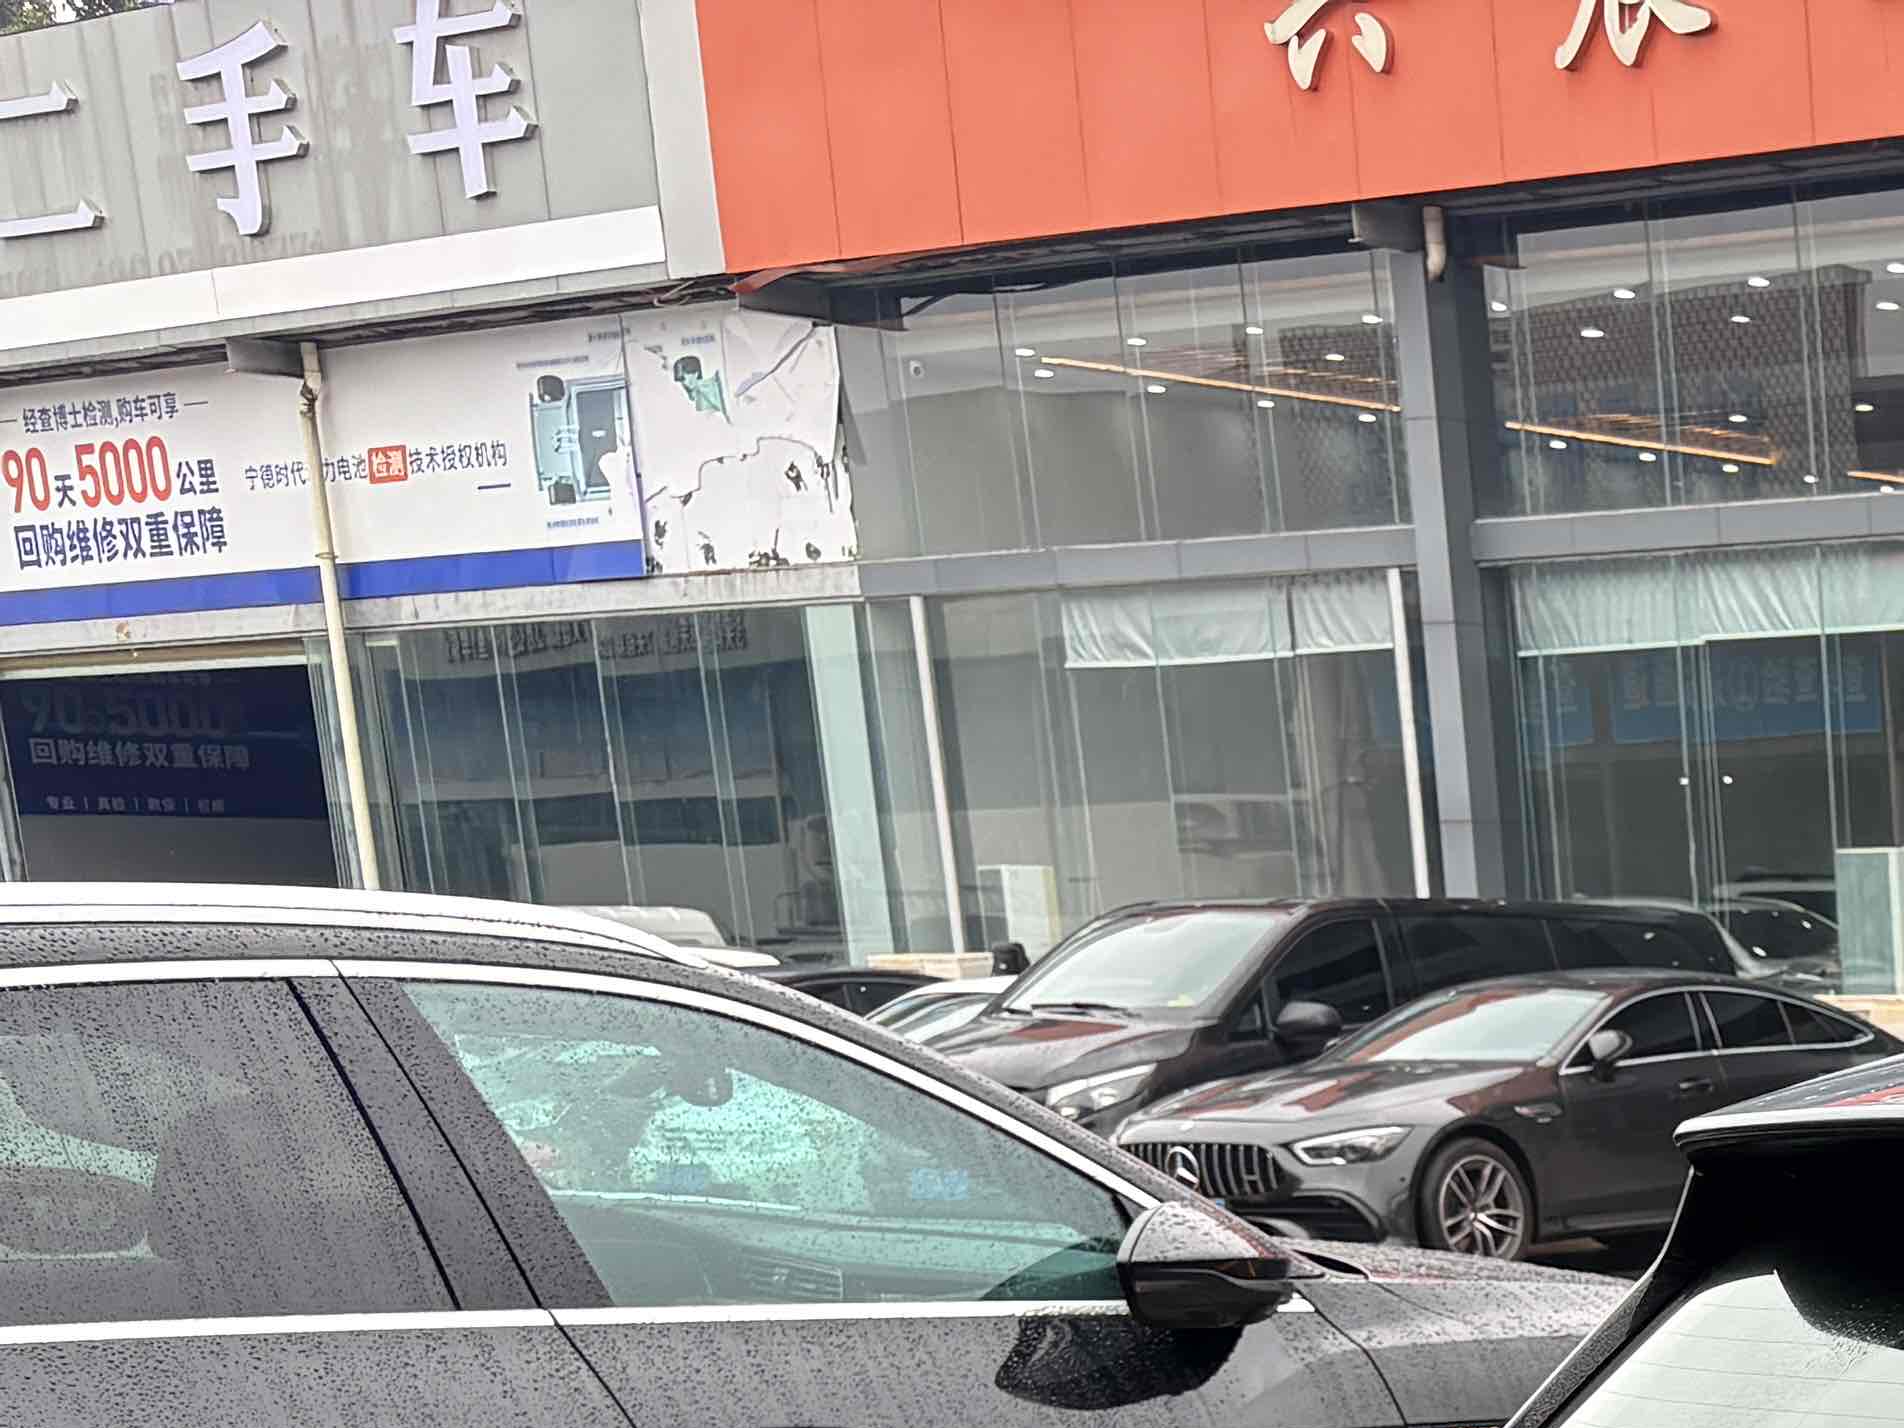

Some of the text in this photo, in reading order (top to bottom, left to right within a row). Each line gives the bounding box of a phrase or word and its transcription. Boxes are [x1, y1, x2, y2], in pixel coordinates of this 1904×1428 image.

[244, 441, 509, 491] 宁德时代力电池检测技术授权机构
[14, 506, 229, 571] 回购维修双重保障
